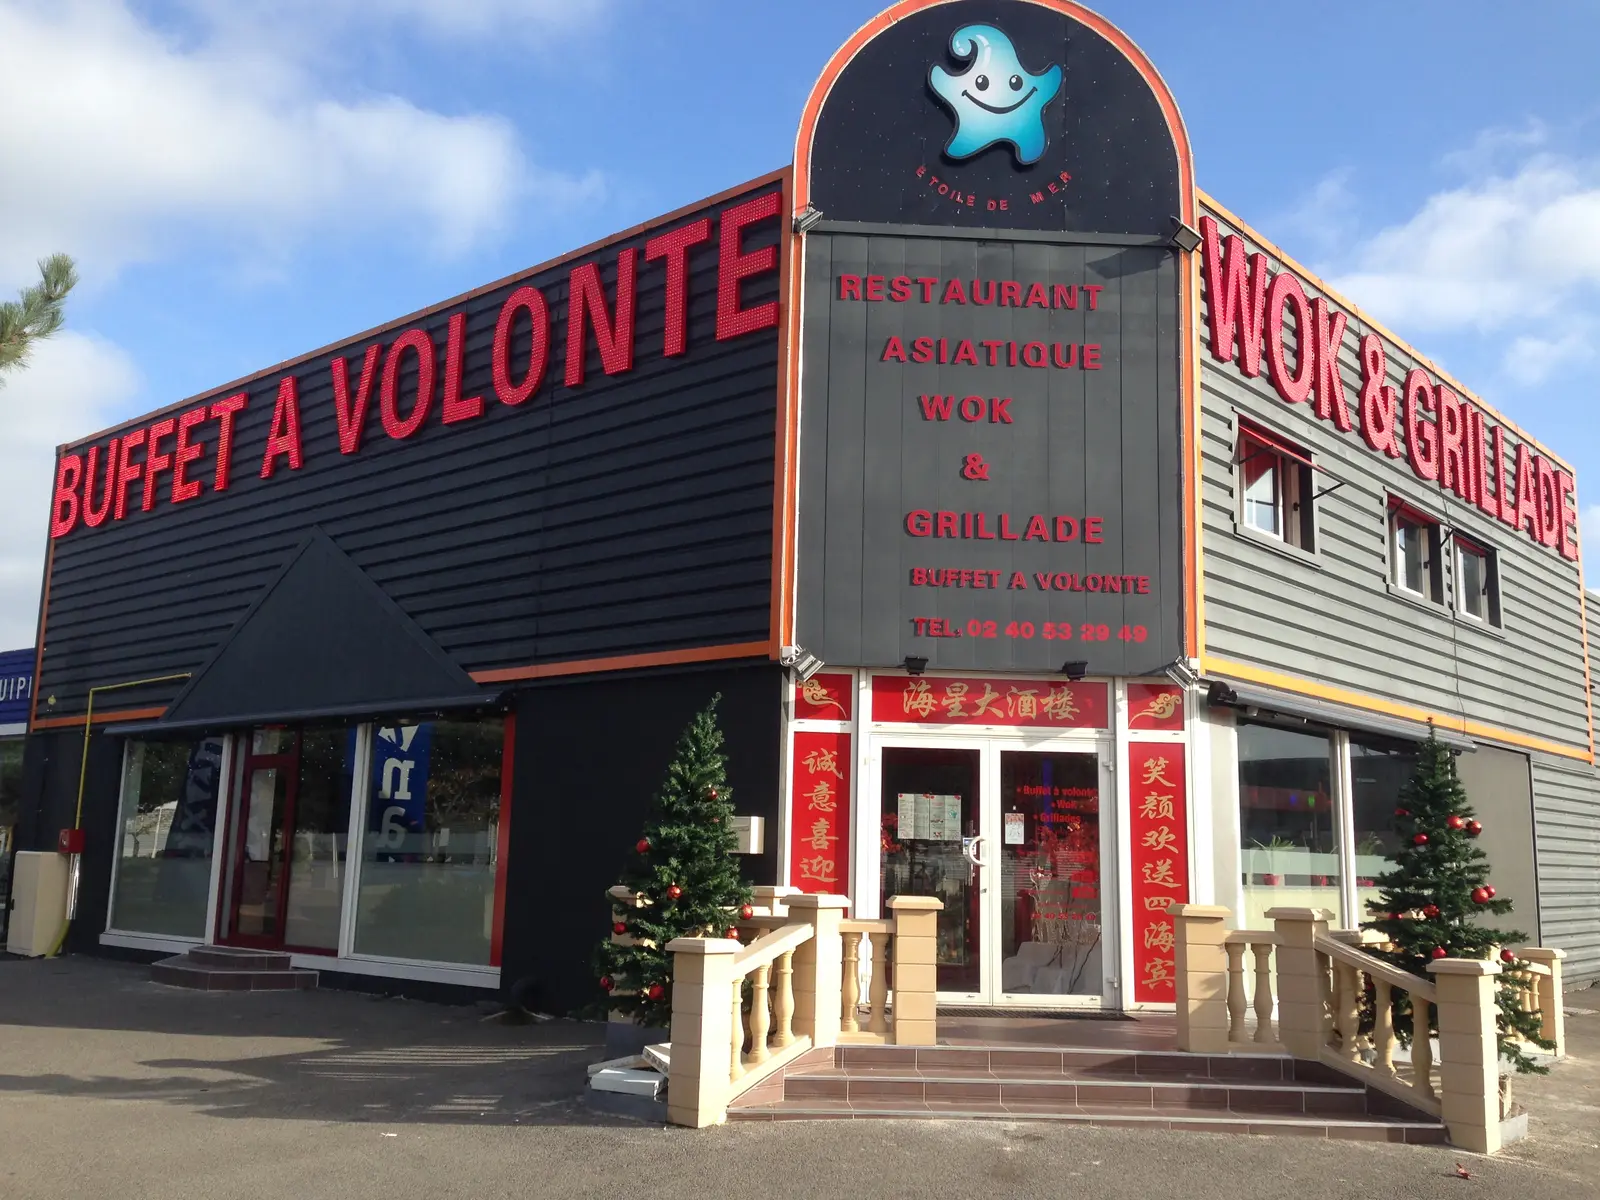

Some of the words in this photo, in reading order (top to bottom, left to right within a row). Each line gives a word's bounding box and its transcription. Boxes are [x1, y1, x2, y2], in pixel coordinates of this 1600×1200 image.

[986, 199, 1009, 211] DE
[1029, 171, 1072, 204] MER
[839, 273, 1104, 311] RESTAURANT
[51, 391, 249, 539] BUFFET
[260, 375, 303, 479] A
[331, 191, 782, 456] VOLONTE
[881, 335, 1103, 371] ASIATIQUE
[1198, 215, 1353, 433] WOK
[1359, 333, 1400, 459] &
[1402, 367, 1580, 562] GRILLADE
[919, 394, 1014, 424] WOK
[963, 452, 991, 481] &
[905, 509, 1104, 544] GRILLADE
[911, 566, 1002, 590] BUFFET
[1010, 570, 1028, 590] A
[1036, 571, 1151, 595] VOLONTE
[966, 619, 998, 639] 02
[1004, 621, 1036, 639] 40
[1042, 622, 1073, 641] 53
[1080, 623, 1111, 642] 29
[1117, 624, 1148, 643] 49
[902, 679, 1081, 721] 海星大酒楼
[799, 747, 844, 894] 诚意喜迎
